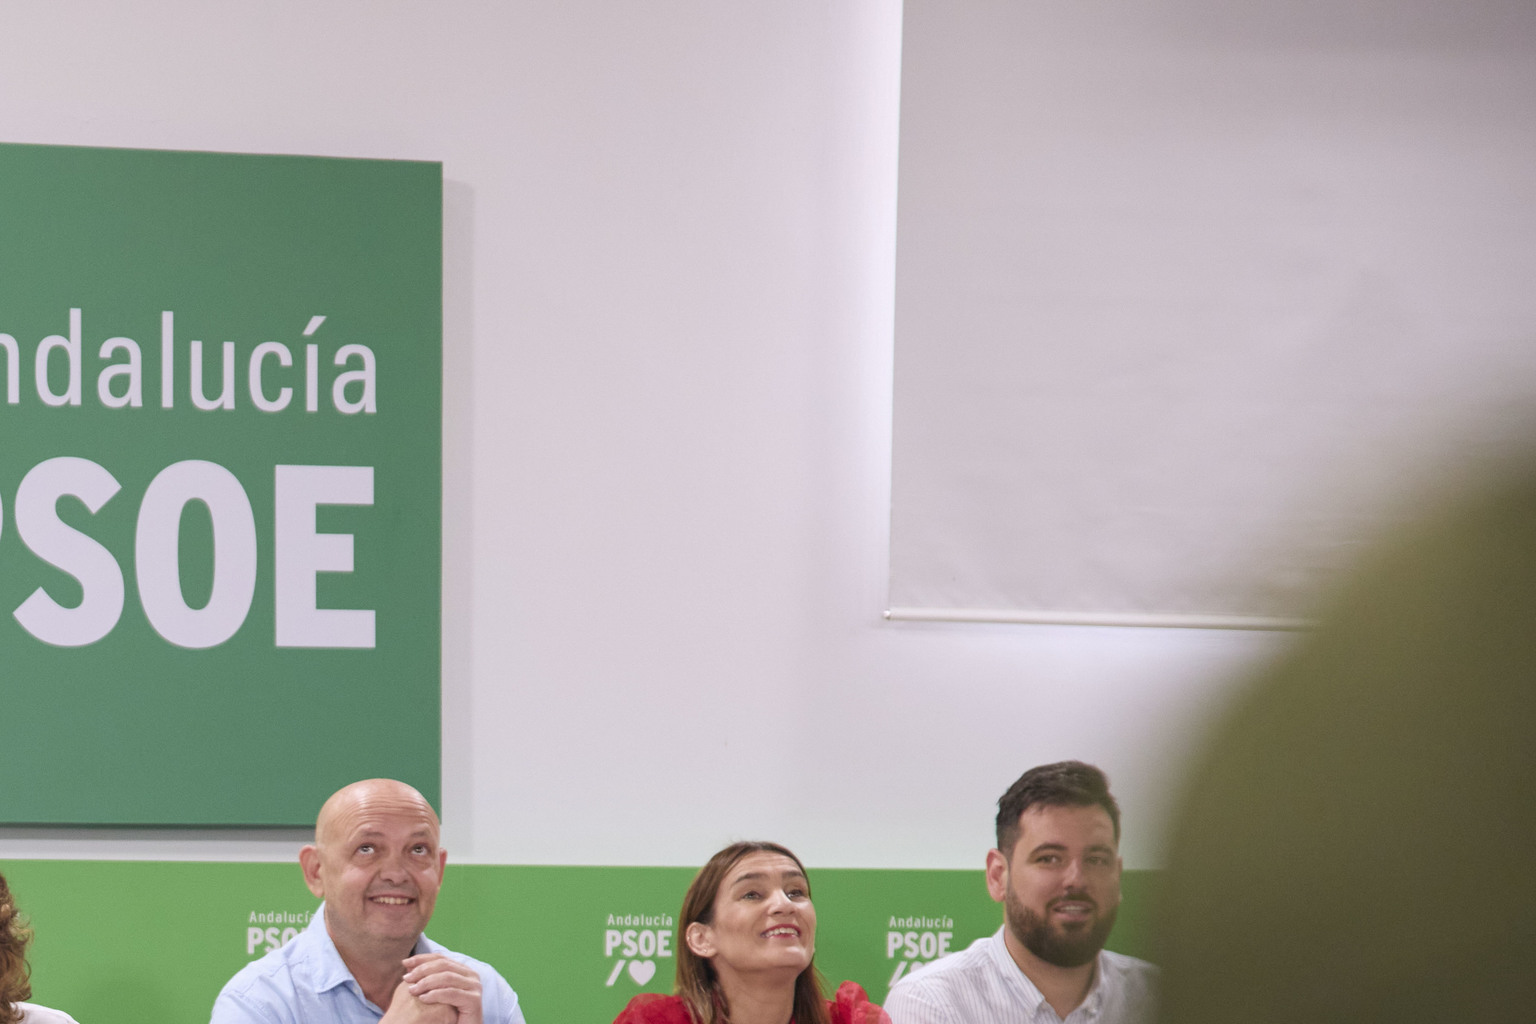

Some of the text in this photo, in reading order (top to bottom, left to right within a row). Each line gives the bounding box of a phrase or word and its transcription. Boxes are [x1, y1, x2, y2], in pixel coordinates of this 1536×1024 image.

[607, 913, 673, 926] Andalucía
[888, 915, 954, 928] Andalucía
[247, 926, 308, 955] PSO
[605, 929, 673, 957] PSOE
[887, 931, 953, 959] PSOE
